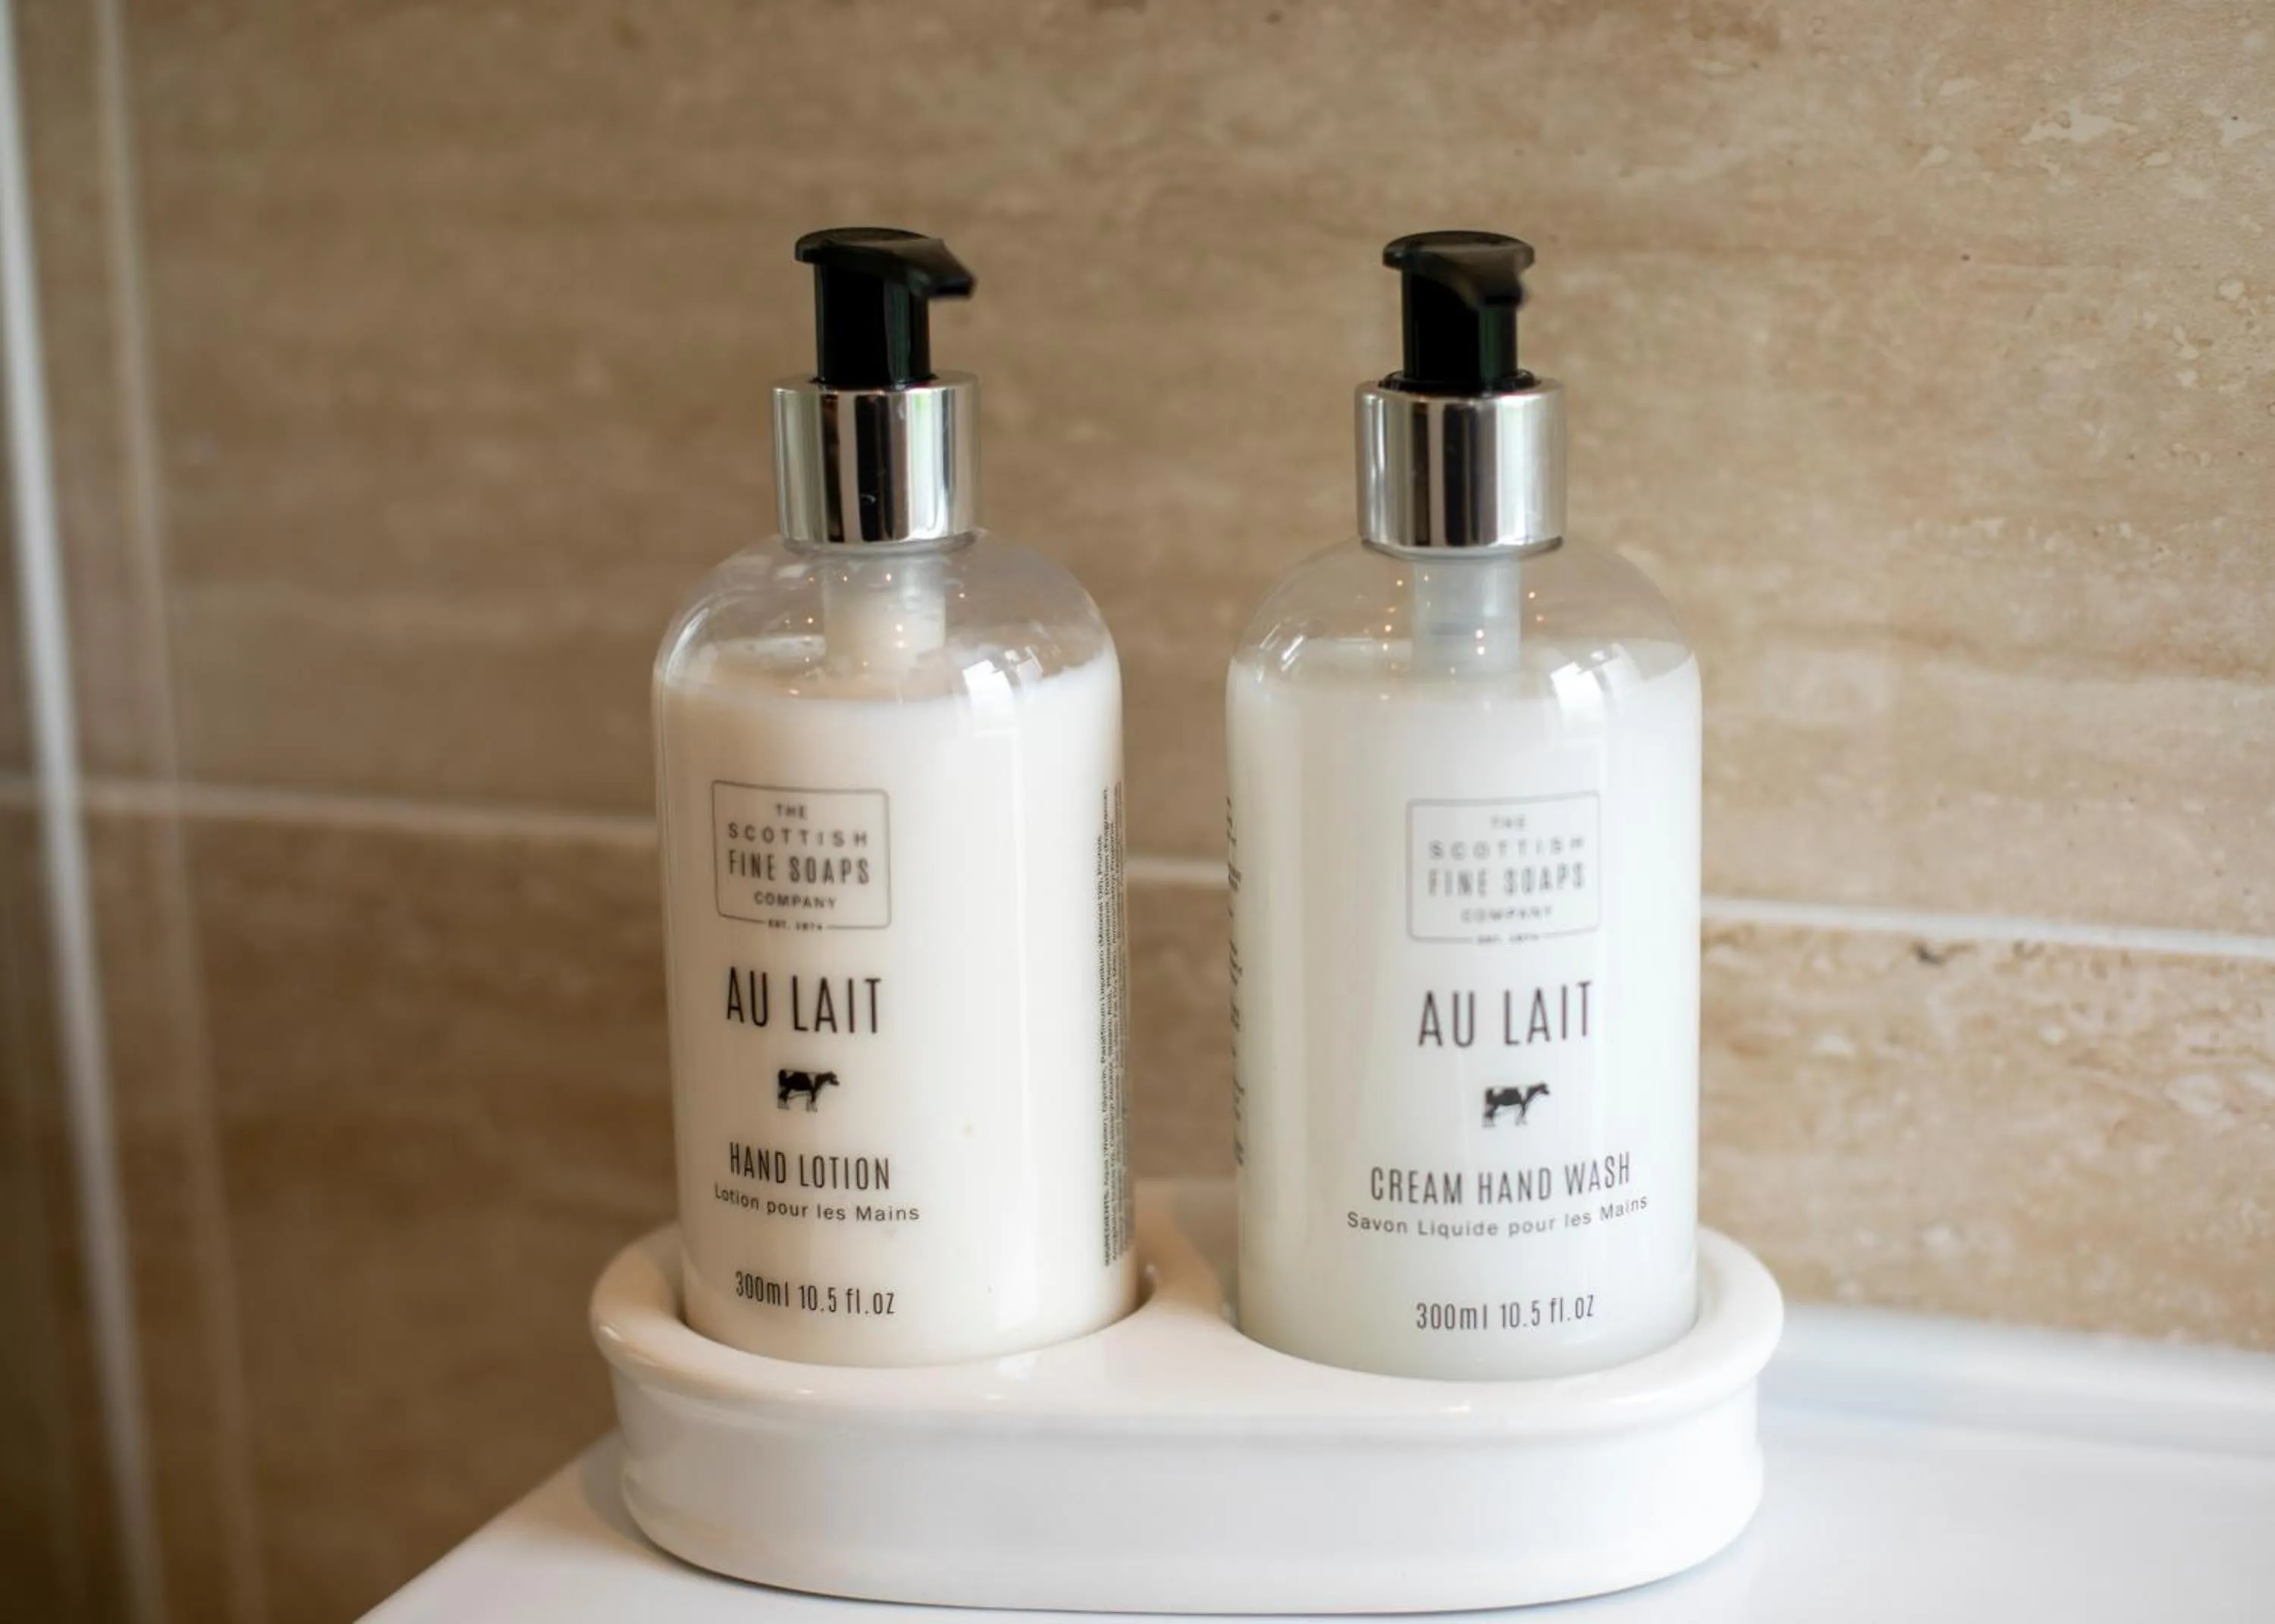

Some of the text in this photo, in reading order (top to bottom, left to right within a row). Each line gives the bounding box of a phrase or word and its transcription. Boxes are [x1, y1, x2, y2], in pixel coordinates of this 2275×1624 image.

[775, 803, 808, 820] THE
[728, 822, 868, 848] SCOTTISH
[729, 849, 870, 885] FINE SOAPS
[1428, 867, 1487, 898] FINE
[754, 890, 837, 908] COMPANY
[727, 967, 881, 1033] AU LAIT
[1418, 980, 1592, 1048] AU LAIT
[730, 1142, 890, 1190] HAND LOTION
[1370, 1152, 1630, 1205] CREAM HAND WASH
[714, 1182, 920, 1221] Lotion pour les Mains
[1348, 1196, 1648, 1238] Savon Liquide pour les Mains
[736, 1271, 789, 1307] 300ml
[799, 1285, 837, 1312] 10.5
[1417, 1303, 1487, 1330] 300ml
[1500, 1300, 1540, 1328] 10.5
